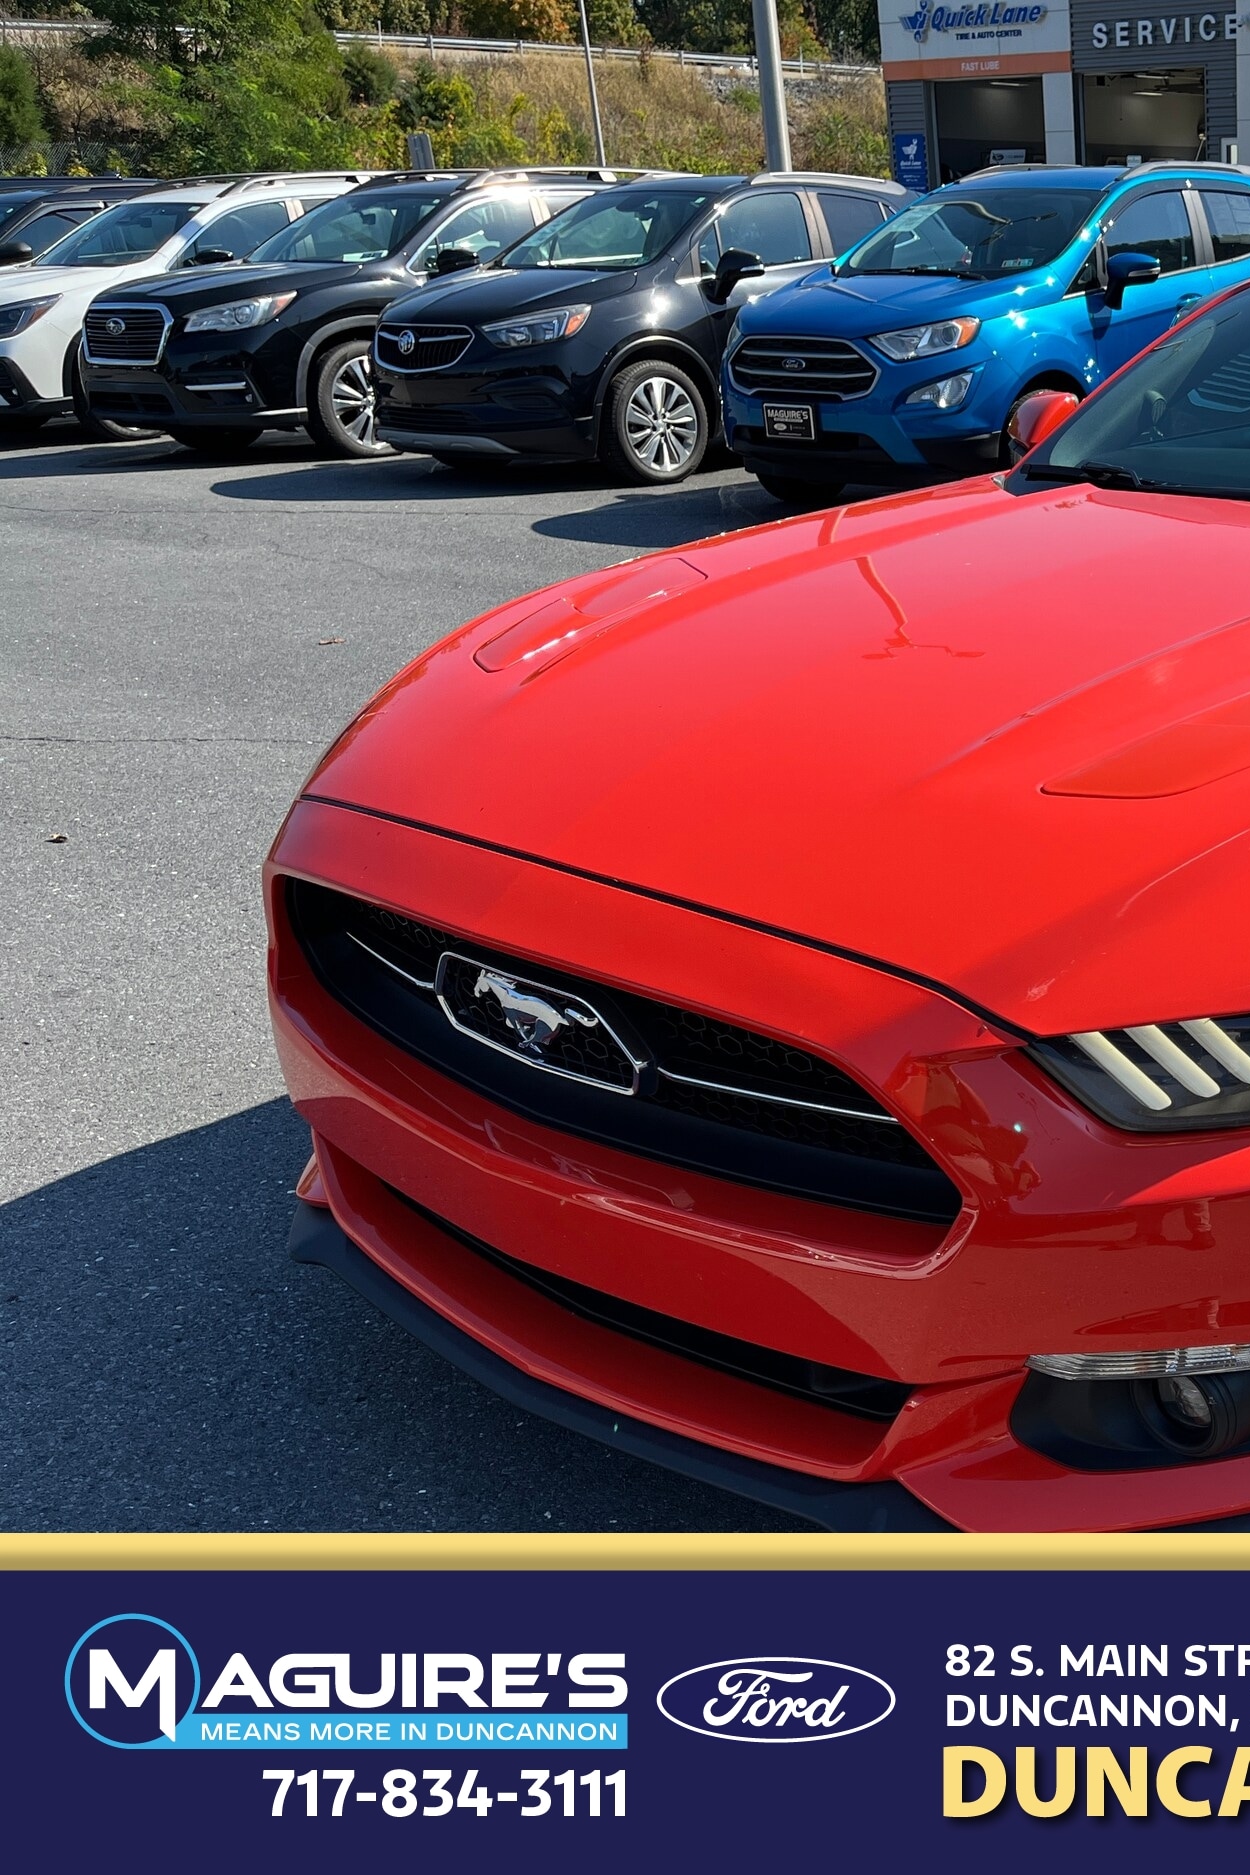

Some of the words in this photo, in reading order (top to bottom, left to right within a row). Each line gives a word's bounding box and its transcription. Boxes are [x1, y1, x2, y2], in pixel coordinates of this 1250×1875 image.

[931, 4, 987, 32] Quick
[989, 3, 1041, 24] Lane
[977, 31, 995, 39] AUTO
[996, 29, 1022, 38] CENTER
[1092, 13, 1237, 49] SERVICE
[961, 62, 978, 71] FAST
[980, 61, 1000, 70] LUBE
[767, 408, 809, 420] MAGUIRE'S
